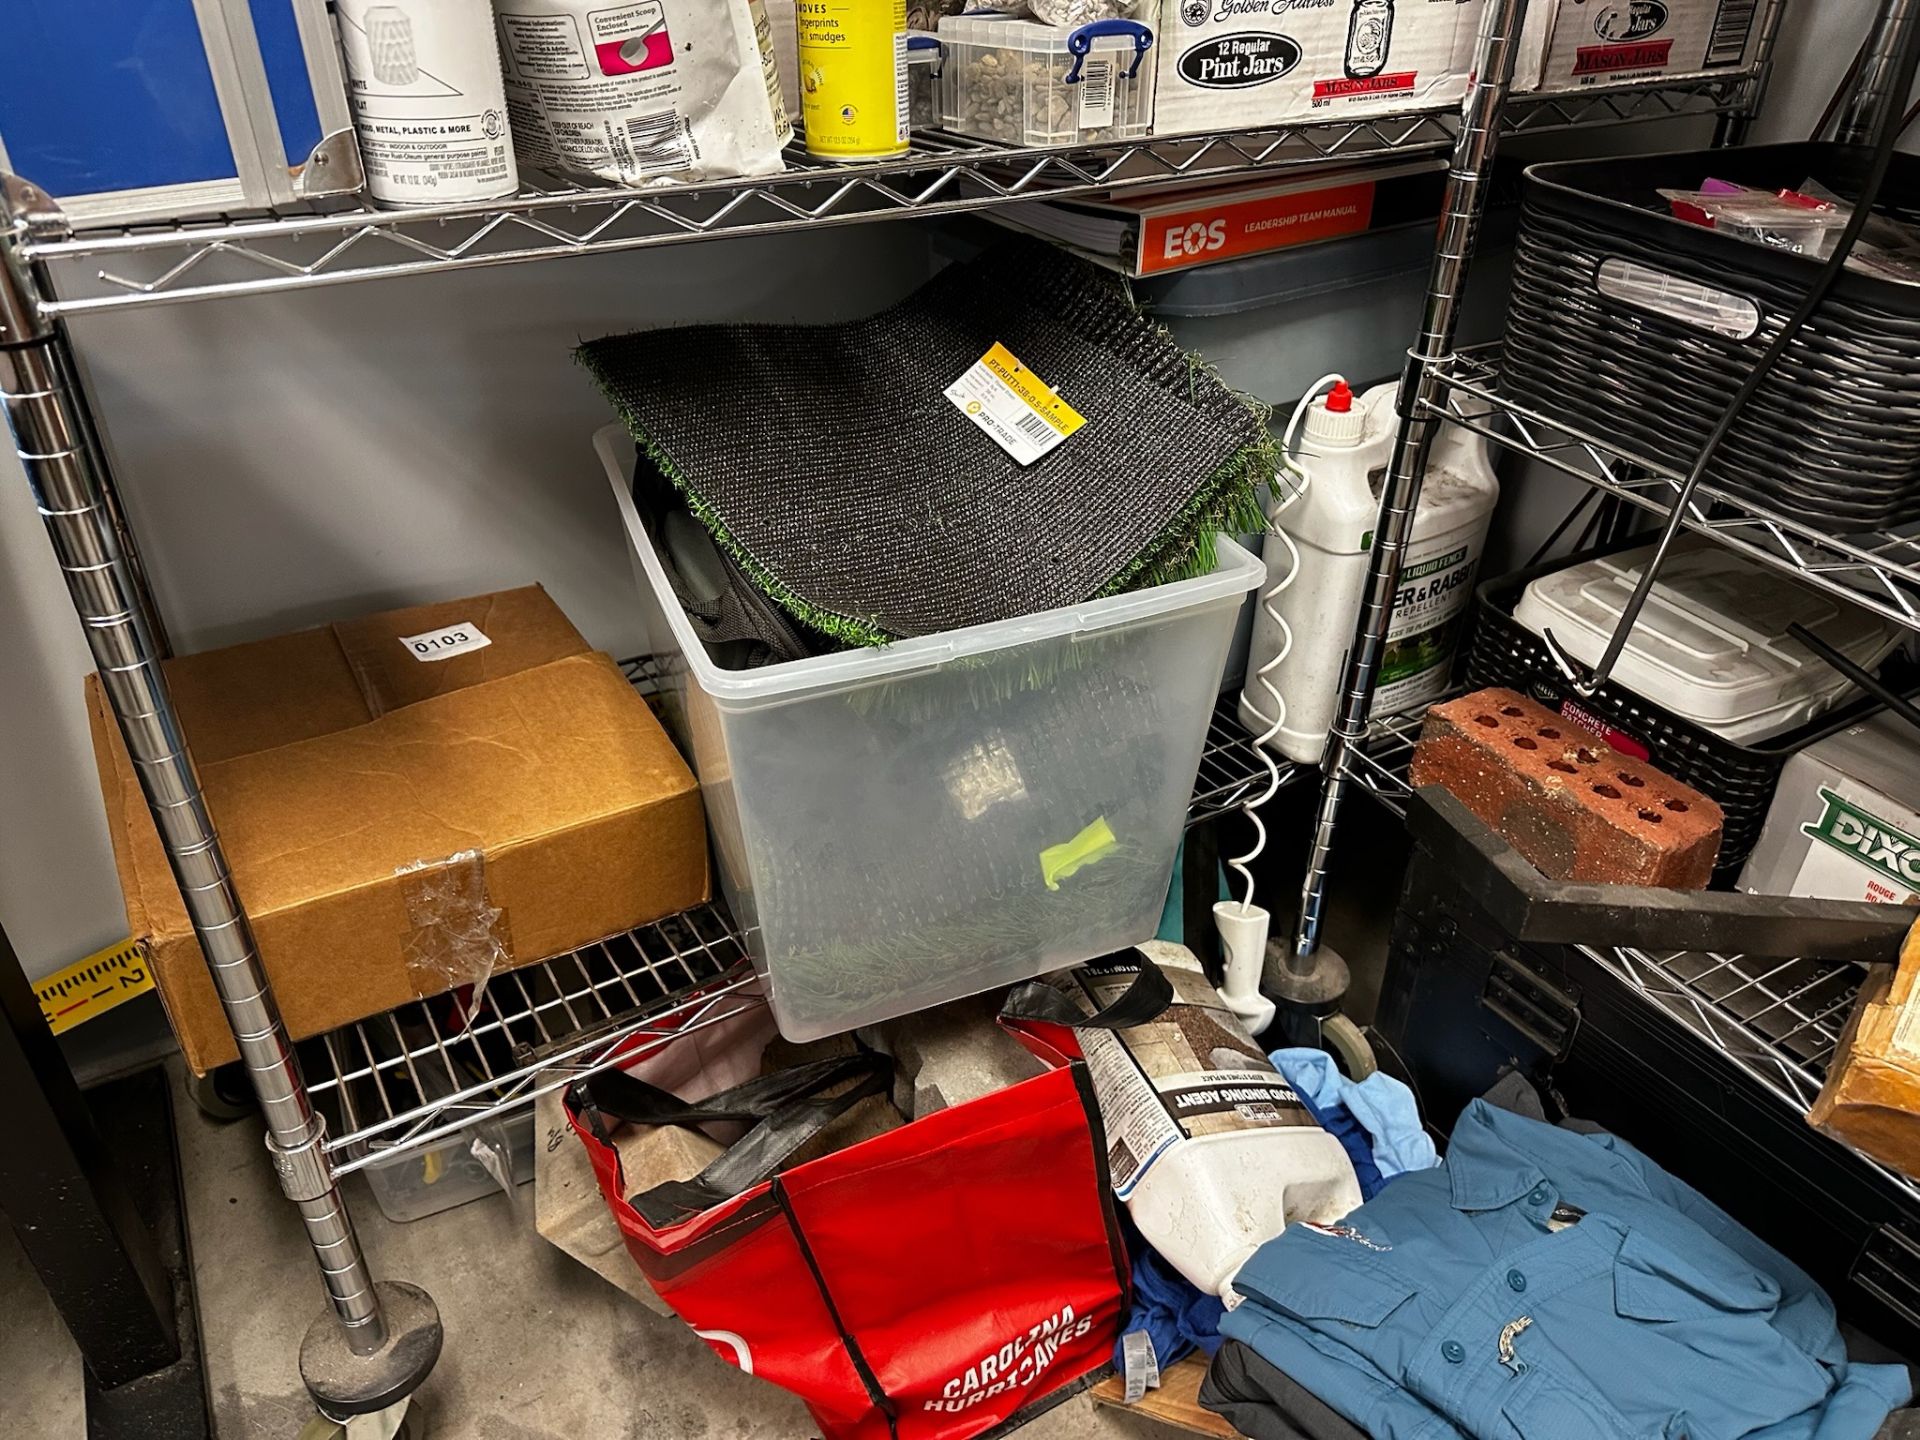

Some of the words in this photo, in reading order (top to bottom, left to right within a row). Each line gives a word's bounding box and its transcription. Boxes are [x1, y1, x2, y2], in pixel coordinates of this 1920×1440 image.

[594, 12, 635, 23] Convenient
[636, 8, 656, 17] Scoop
[1631, 15, 1657, 32] Jars
[596, 21, 628, 31] Enclosed
[809, 32, 845, 43] smudges
[1217, 42, 1230, 55] 12
[1232, 39, 1271, 54] Regular
[1199, 57, 1240, 80] Pint
[1241, 53, 1284, 76] Jars
[1577, 52, 1626, 70] MASON
[1628, 48, 1665, 66] JARS
[1325, 79, 1363, 94] MASON
[1312, 98, 1322, 108] 500
[376, 125, 401, 136] METAL,
[402, 127, 437, 135] PLASTIC
[440, 126, 446, 134] &
[449, 125, 471, 133] MORE
[424, 152, 445, 161] general
[447, 152, 470, 160] purpose
[1164, 218, 1226, 260] EOS
[1244, 214, 1297, 233] LEADERSHIP
[1298, 210, 1323, 224] TEAM
[1323, 204, 1358, 219] MANUAL
[978, 411, 1018, 446] PRO-TRADE
[1406, 560, 1438, 578] LIQUID
[1438, 551, 1464, 570] FENCE
[1417, 587, 1426, 602] &
[414, 632, 469, 653] 0103
[1563, 701, 1613, 736] CONCRETE
[1867, 880, 1896, 901] ROUGE
[1200, 1075, 1220, 1083] PLACE
[1175, 1089, 1219, 1109] AGENT
[1222, 1087, 1272, 1103] BINDING
[943, 1304, 1075, 1399] CAROLINA
[924, 1314, 1093, 1413] HURRICANES
